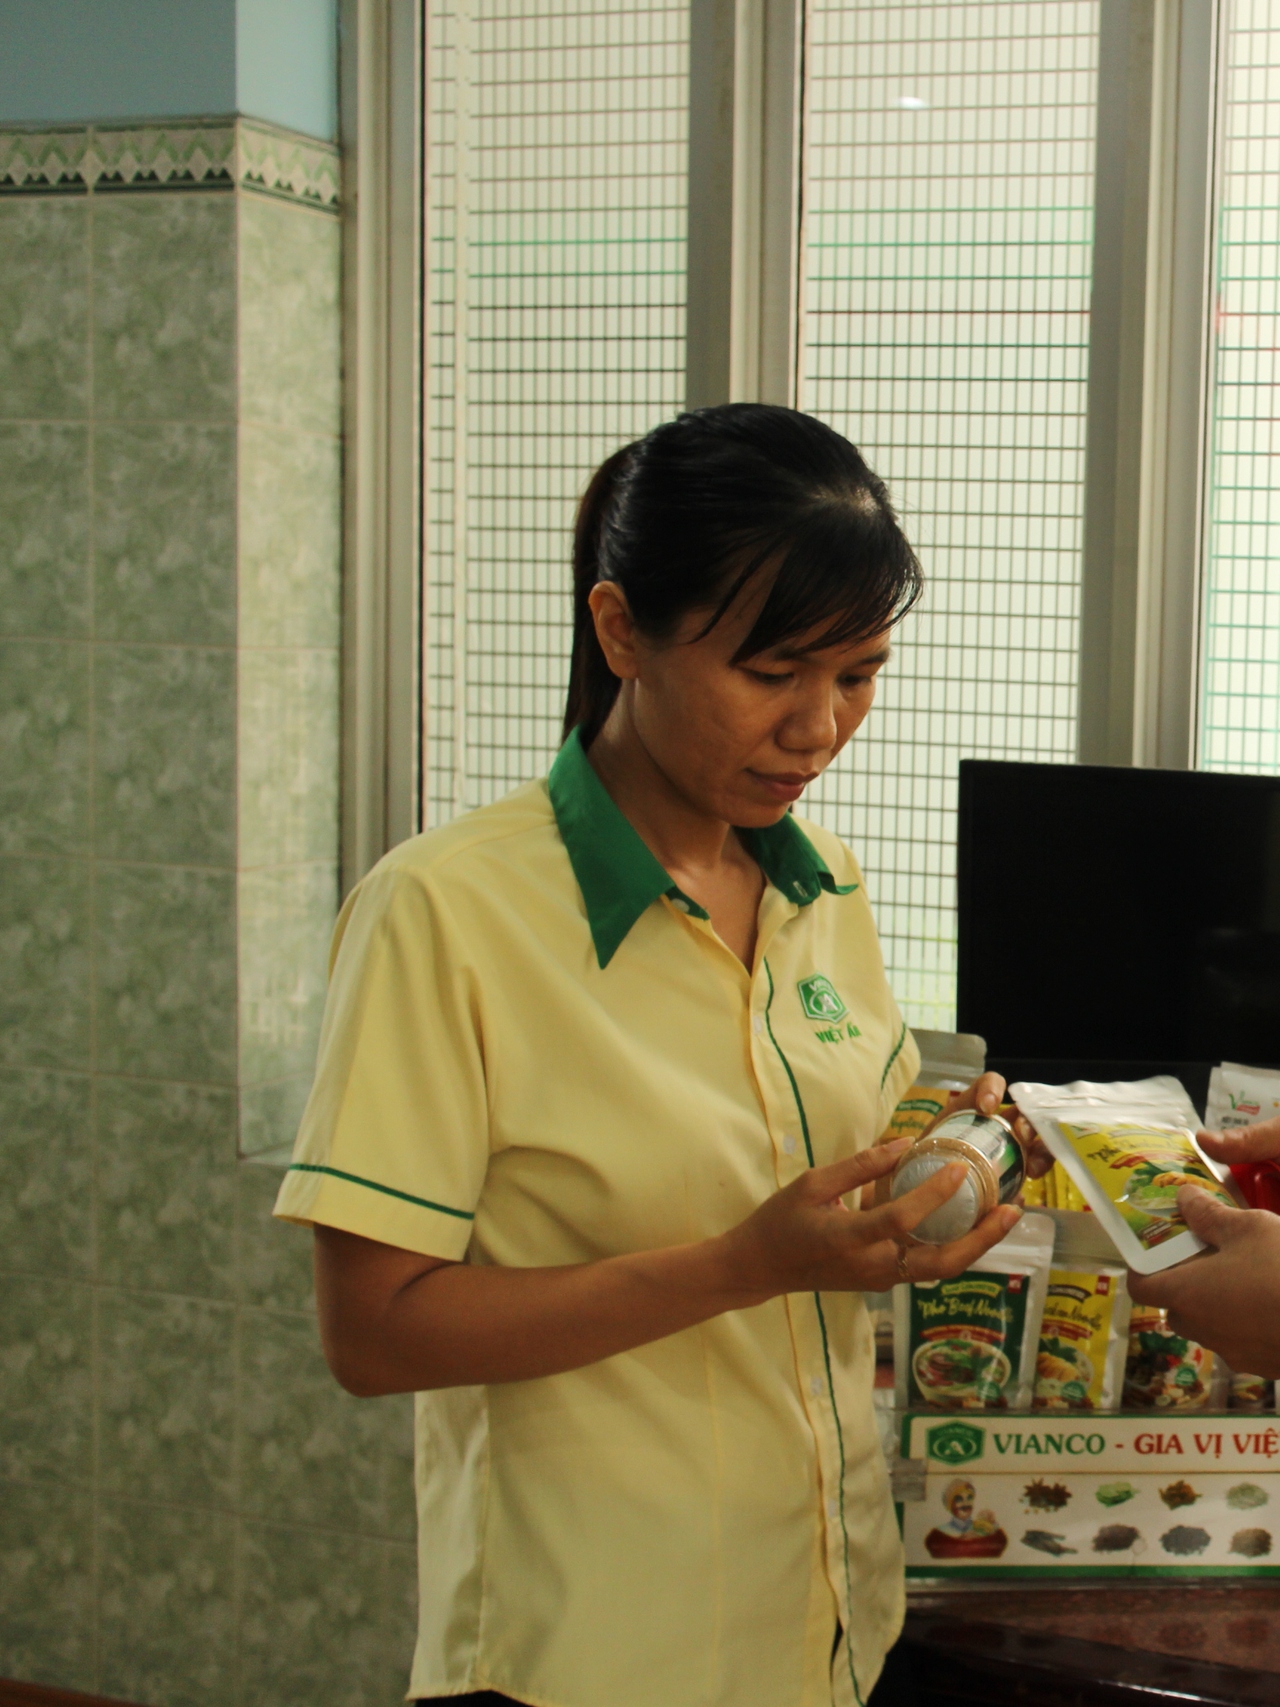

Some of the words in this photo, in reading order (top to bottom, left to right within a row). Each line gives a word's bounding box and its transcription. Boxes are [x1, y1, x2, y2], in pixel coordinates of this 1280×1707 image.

[993, 1433, 1106, 1455] VIANCO
[1133, 1433, 1184, 1455] GIA
[1193, 1433, 1223, 1459] VỊ
